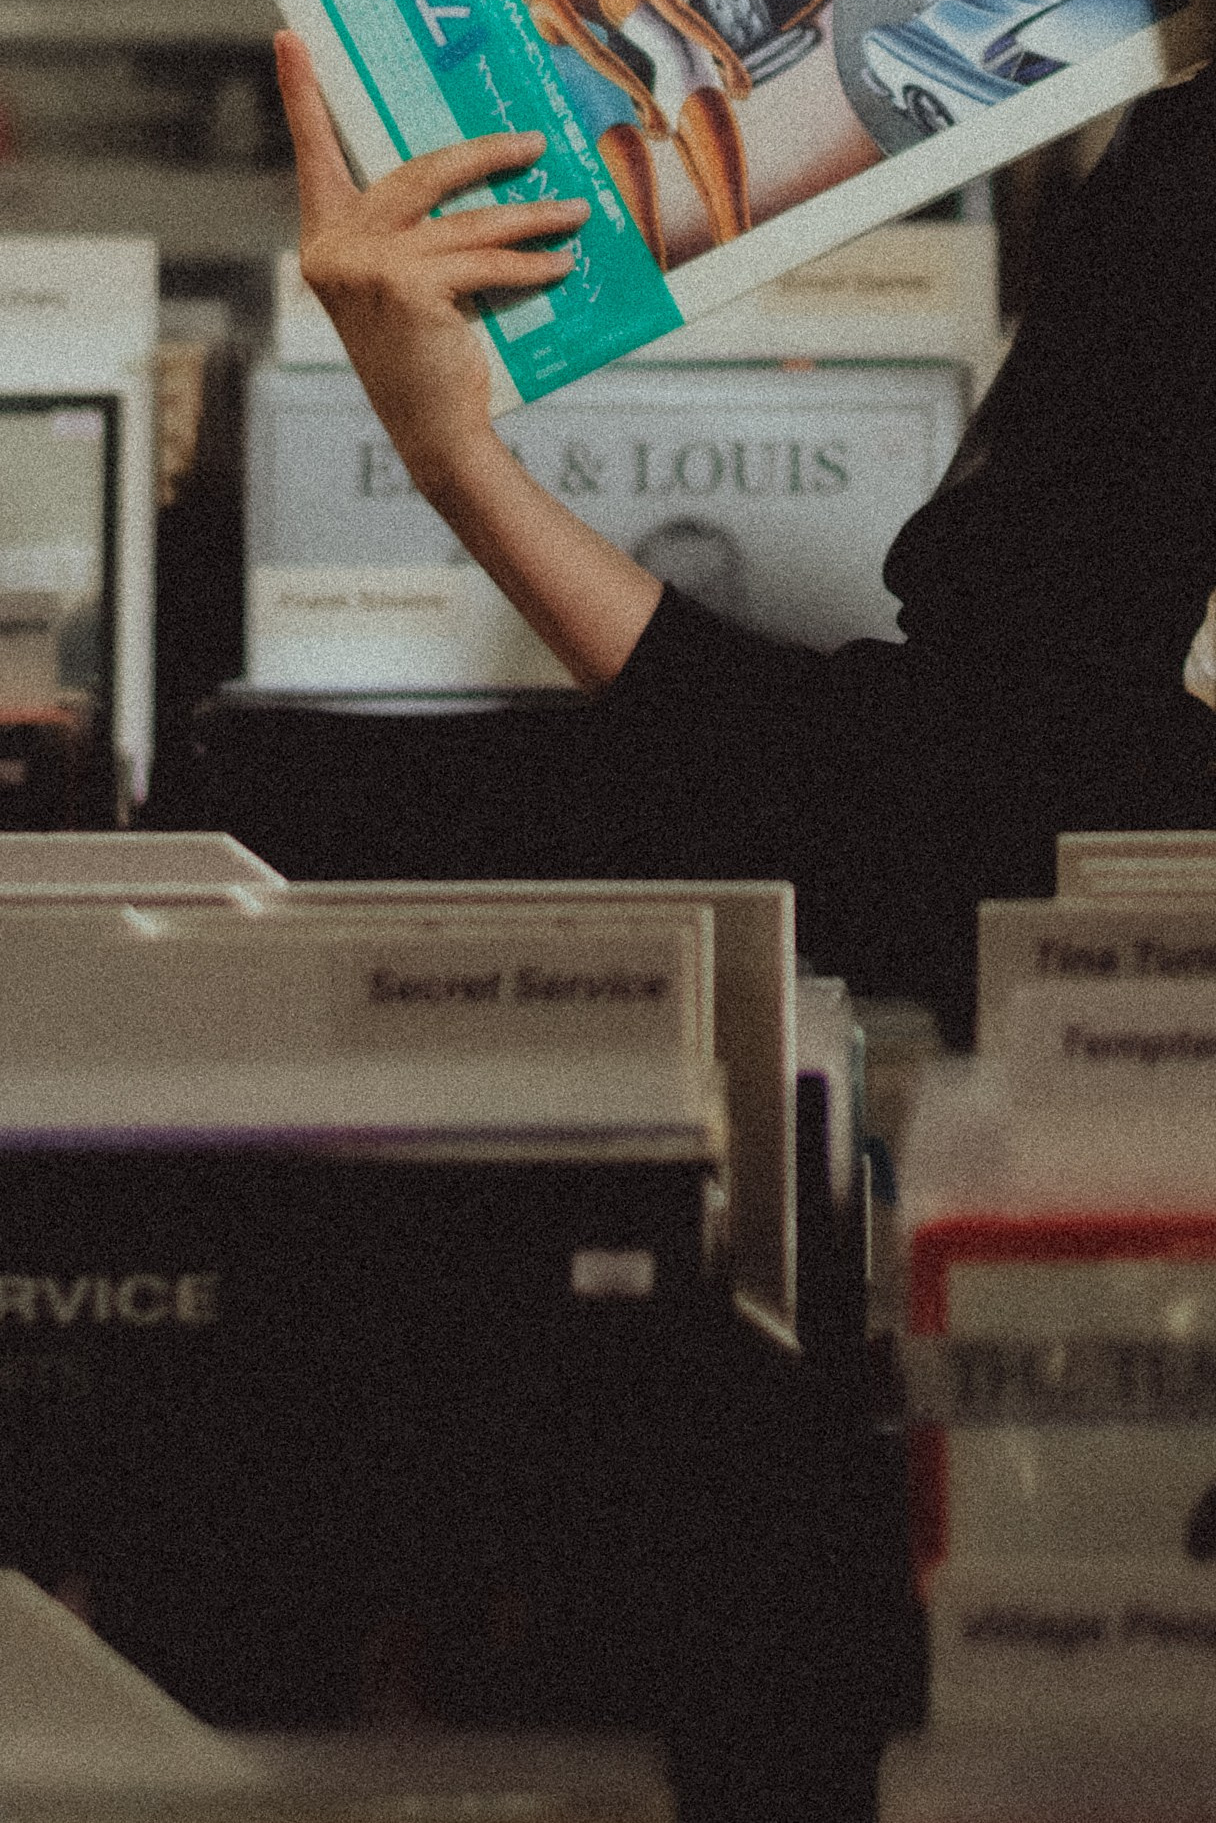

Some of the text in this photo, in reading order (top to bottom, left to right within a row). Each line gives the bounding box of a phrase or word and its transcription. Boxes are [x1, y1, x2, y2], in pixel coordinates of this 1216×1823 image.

[559, 441, 852, 499] & LOUIS
[370, 964, 669, 1003] Secret Service
